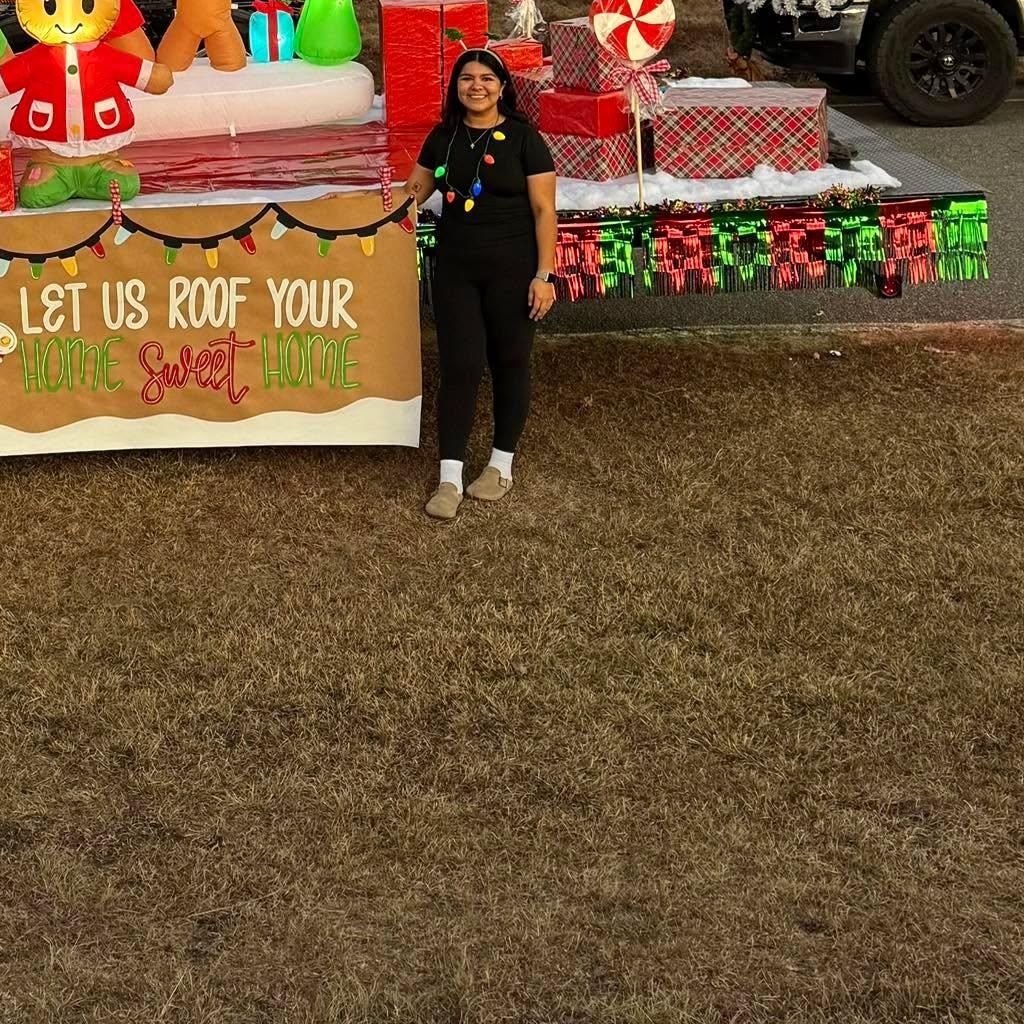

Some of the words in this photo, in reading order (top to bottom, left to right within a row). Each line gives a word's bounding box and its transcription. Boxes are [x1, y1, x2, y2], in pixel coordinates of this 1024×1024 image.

[20, 282, 87, 334] LET
[102, 278, 149, 330] US
[169, 276, 251, 329] ROOF
[266, 277, 358, 329] YOUR
[20, 336, 124, 394] HOME
[139, 331, 256, 405] Sweet
[262, 330, 361, 388] HOME
